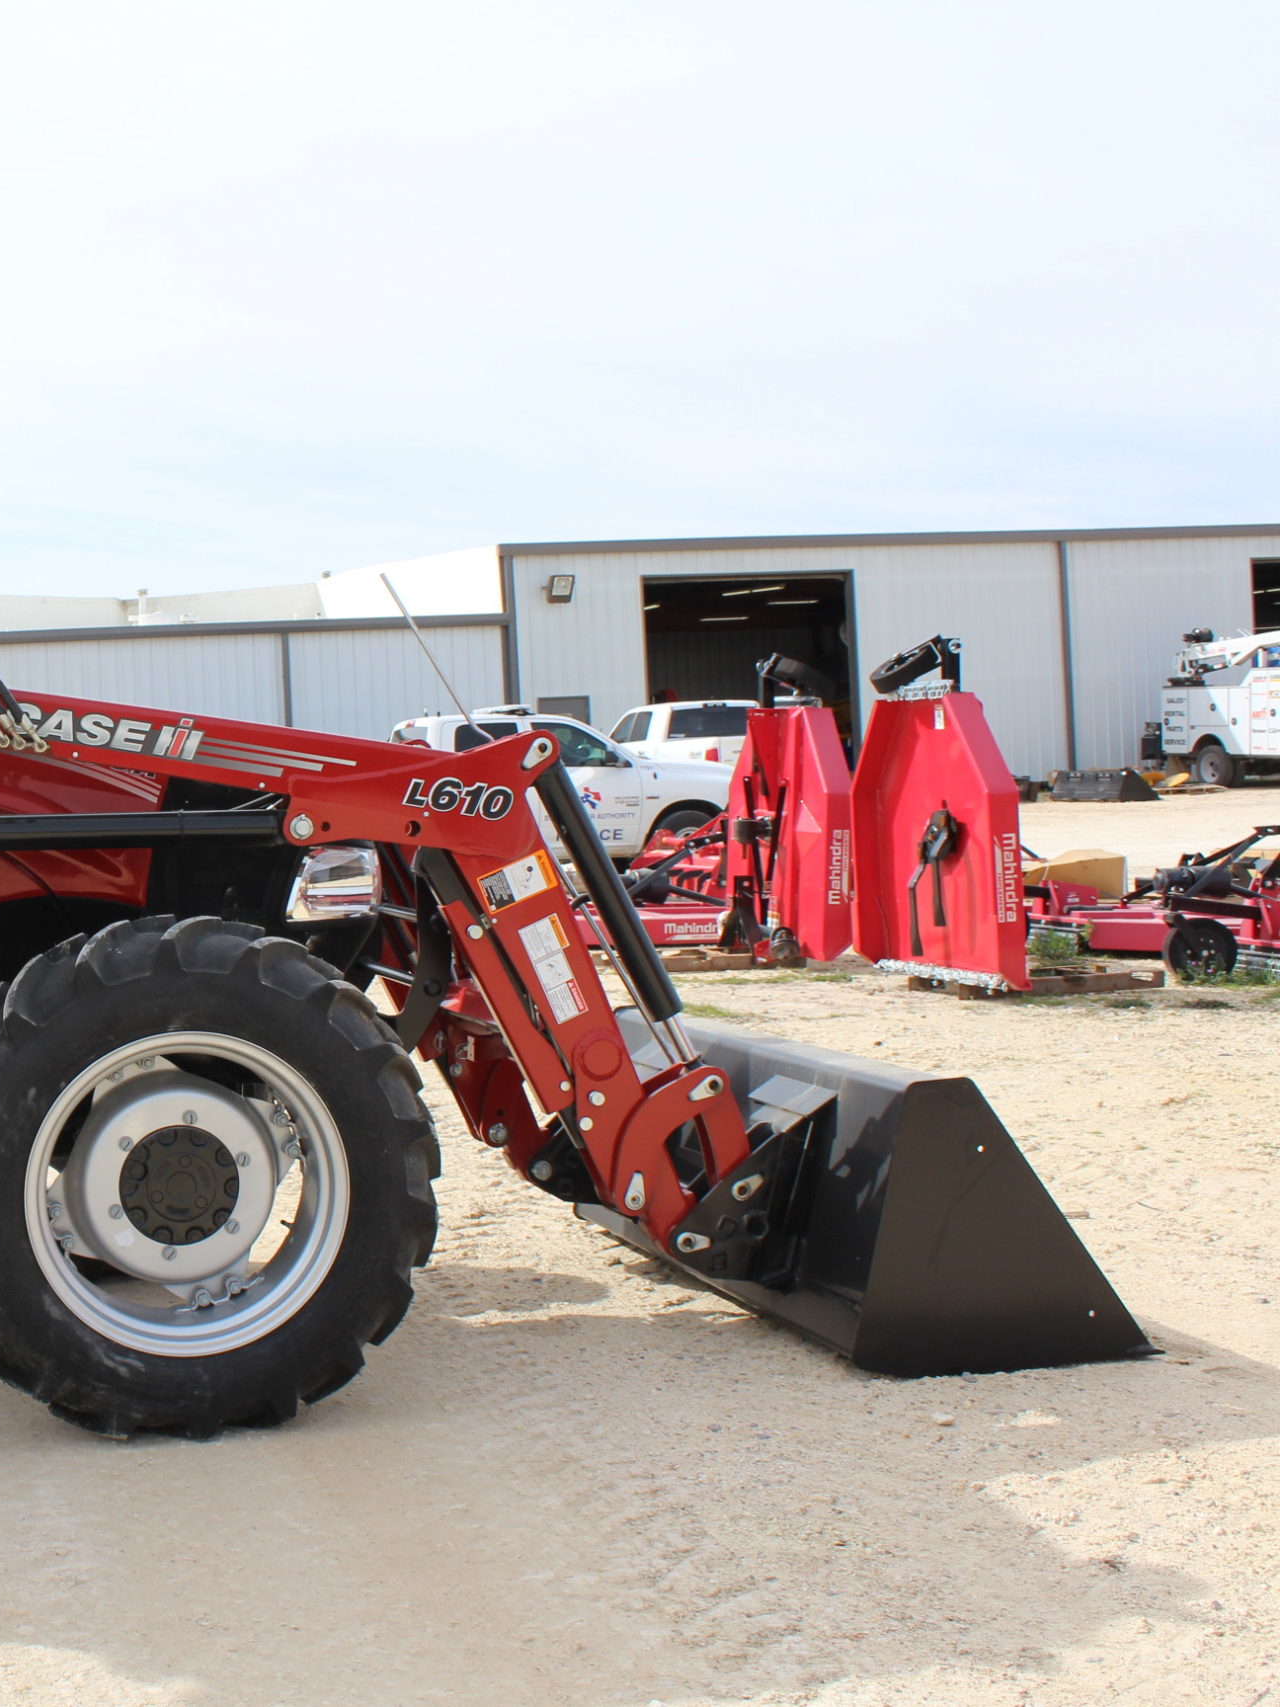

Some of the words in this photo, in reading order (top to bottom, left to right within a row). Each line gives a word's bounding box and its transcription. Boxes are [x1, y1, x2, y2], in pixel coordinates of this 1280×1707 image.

[7, 703, 152, 753] CASE
[402, 776, 514, 821] L610
[597, 812, 635, 820] AUTHORITY
[828, 829, 842, 905] Mahindra
[1002, 833, 1019, 922] Mahindra
[664, 922, 718, 934] Mahindr
